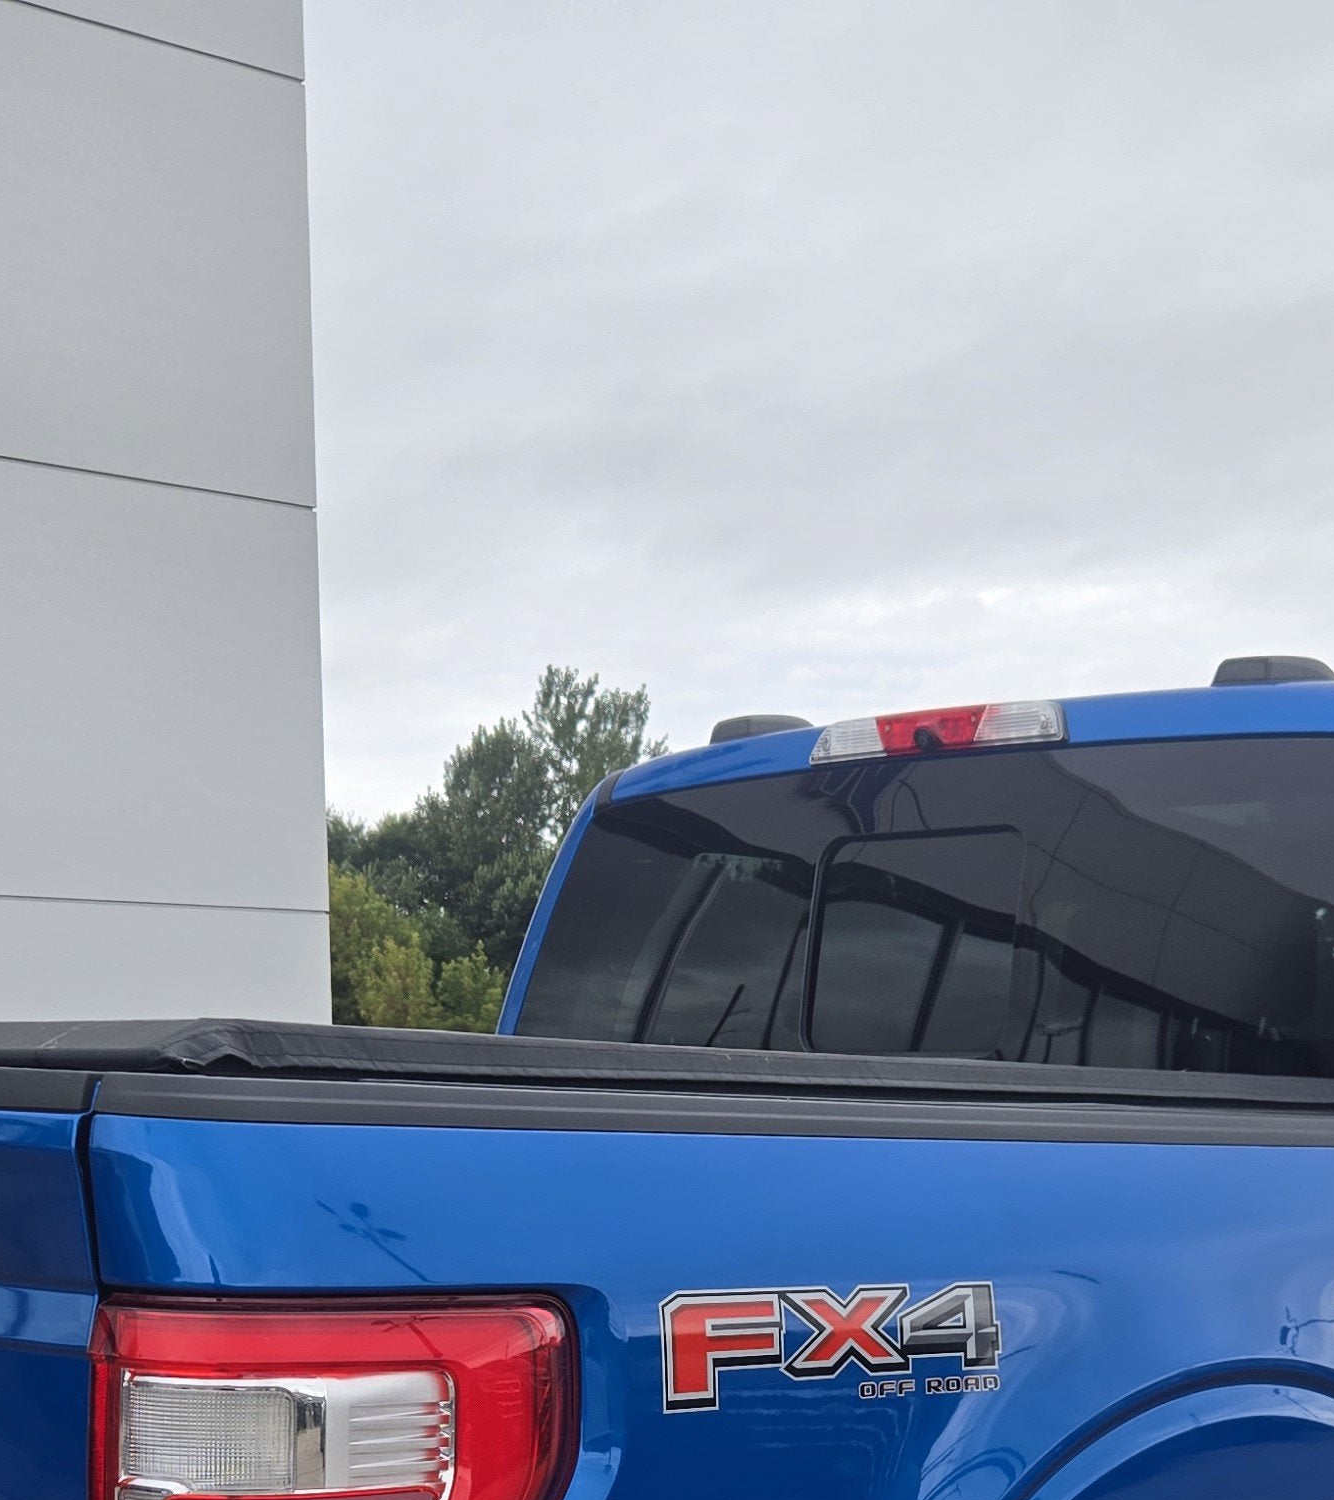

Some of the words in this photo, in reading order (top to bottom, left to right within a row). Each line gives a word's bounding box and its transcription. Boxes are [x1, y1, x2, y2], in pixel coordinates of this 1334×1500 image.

[658, 1281, 1002, 1414] FX4
[858, 1378, 915, 1400] OFF
[925, 1374, 1000, 1396] ROAD
